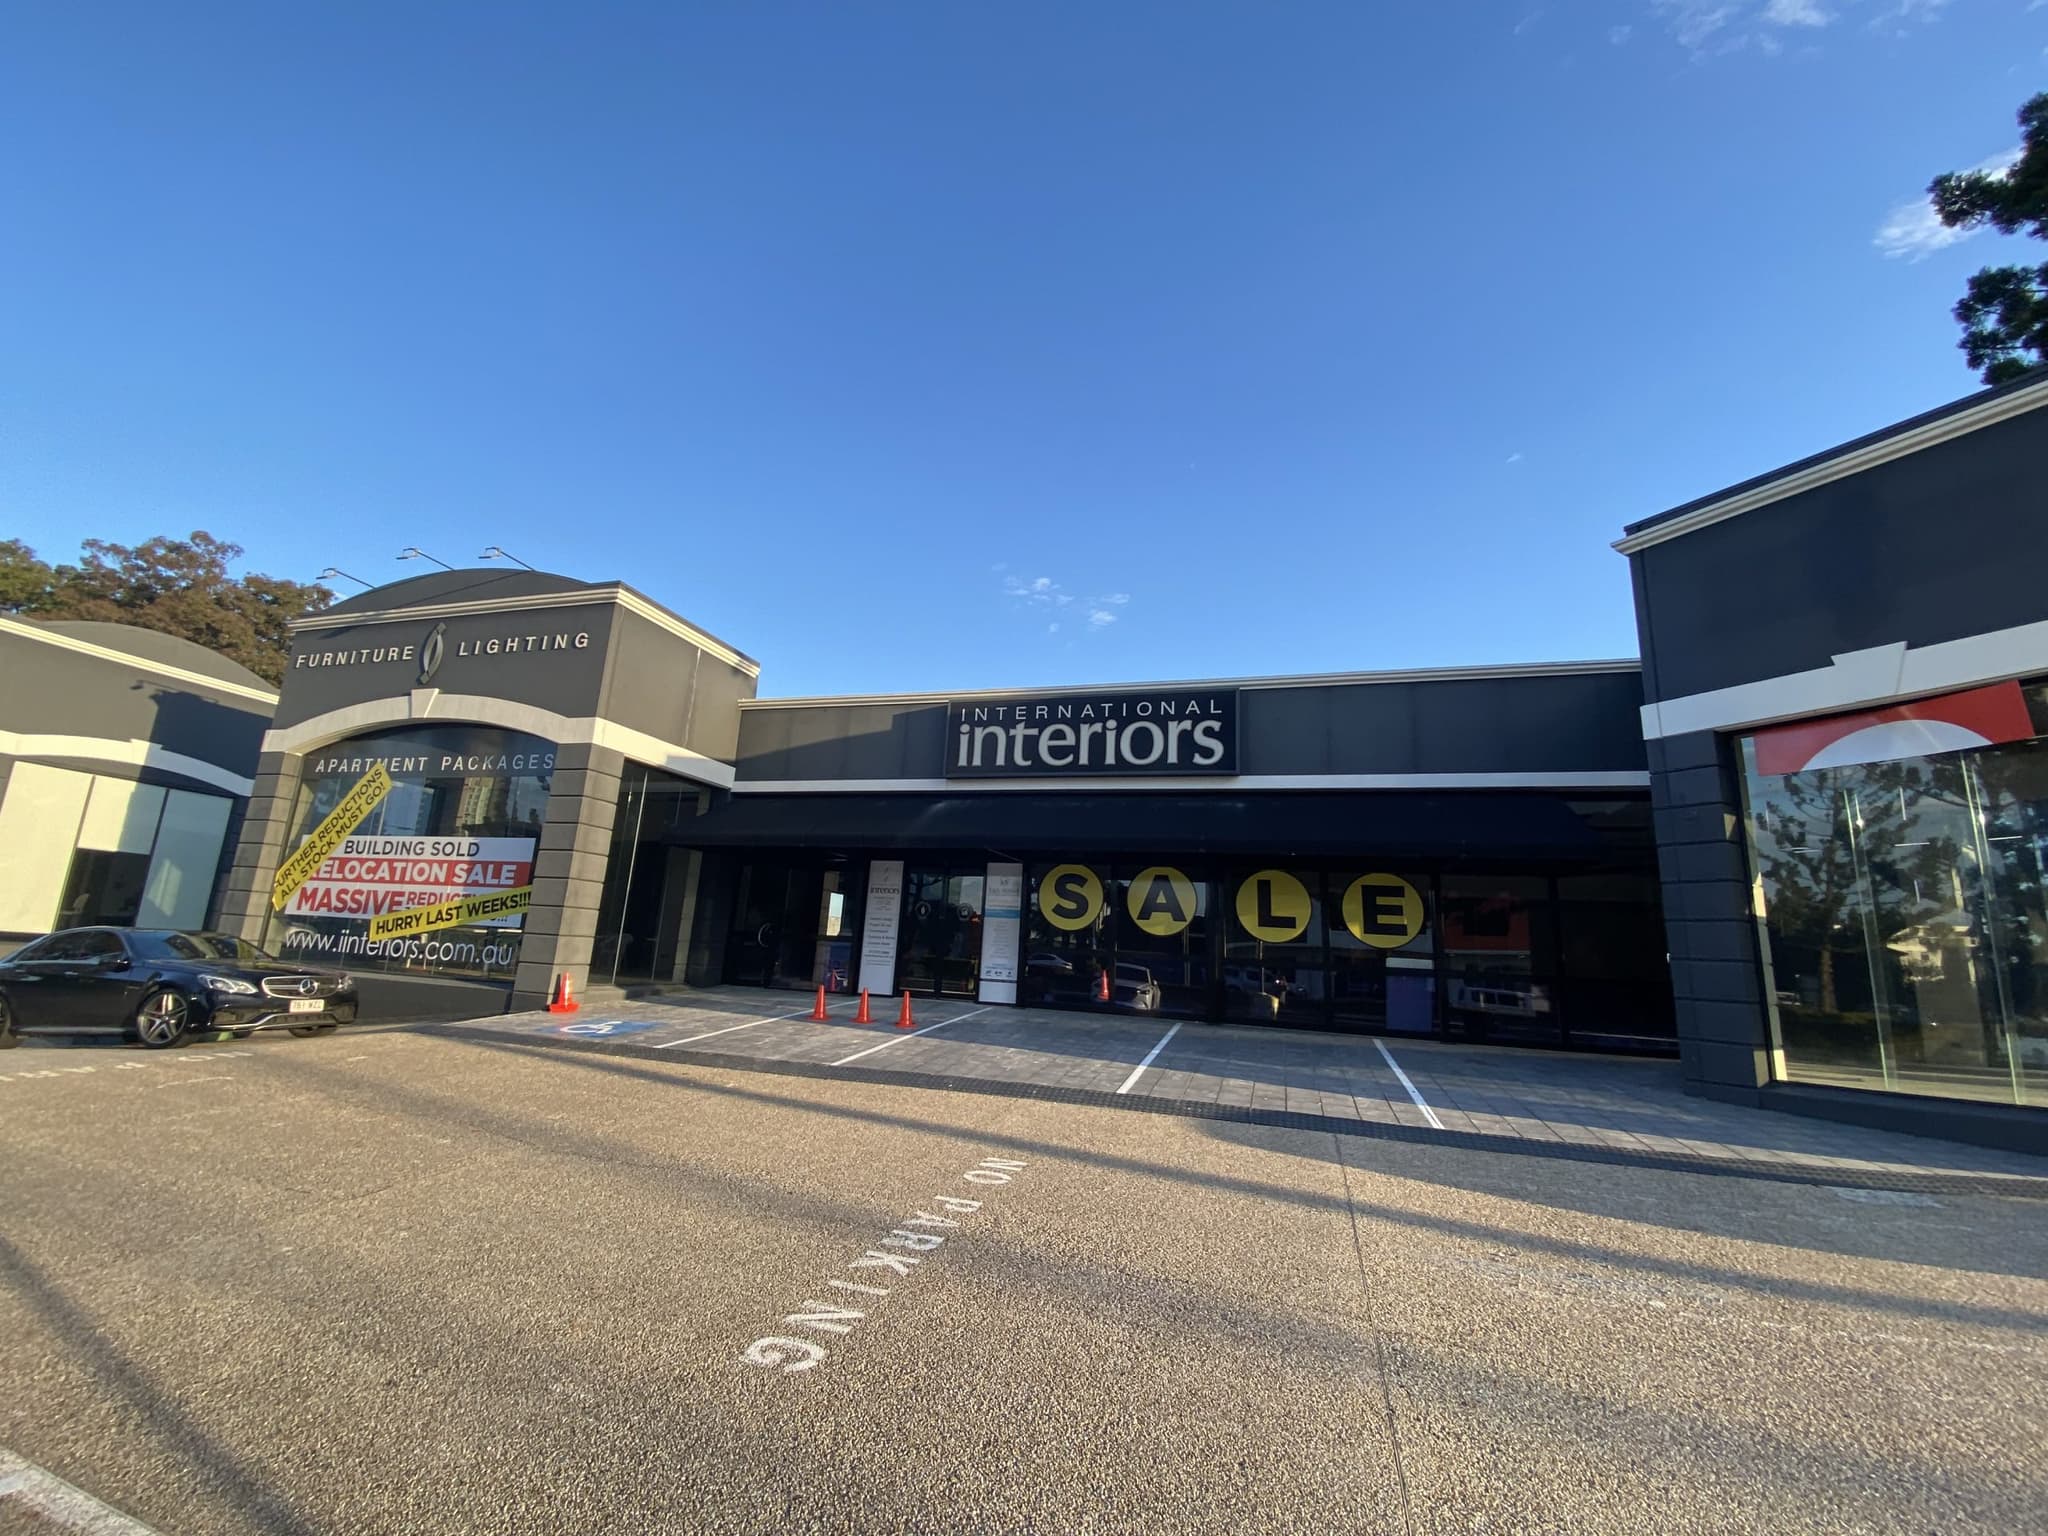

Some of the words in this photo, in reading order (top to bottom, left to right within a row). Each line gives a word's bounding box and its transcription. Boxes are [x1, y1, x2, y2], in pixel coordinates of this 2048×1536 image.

[295, 645, 415, 669] FURNITURE
[458, 632, 590, 657] LIGHTING
[961, 699, 1223, 722] INTERNATIONAL
[957, 719, 1225, 767] interiors
[440, 753, 556, 772] PACKAGES
[317, 768, 383, 844] REDUCTIONS
[280, 879, 301, 901] ALL
[301, 837, 336, 878] STOCK
[336, 804, 364, 839] MUST
[366, 782, 386, 806] GO!
[344, 840, 424, 856] BUILDING
[430, 841, 480, 857] SOLD
[312, 861, 448, 884] ELOCATION
[453, 863, 518, 885] SALE
[296, 887, 406, 915] MASSIVE
[376, 912, 423, 935] HURRY
[426, 905, 463, 926] LAST
[467, 891, 531, 917] WEEKS!!!
[962, 1157, 1029, 1185] NO
[740, 1195, 983, 1373] PARKING
